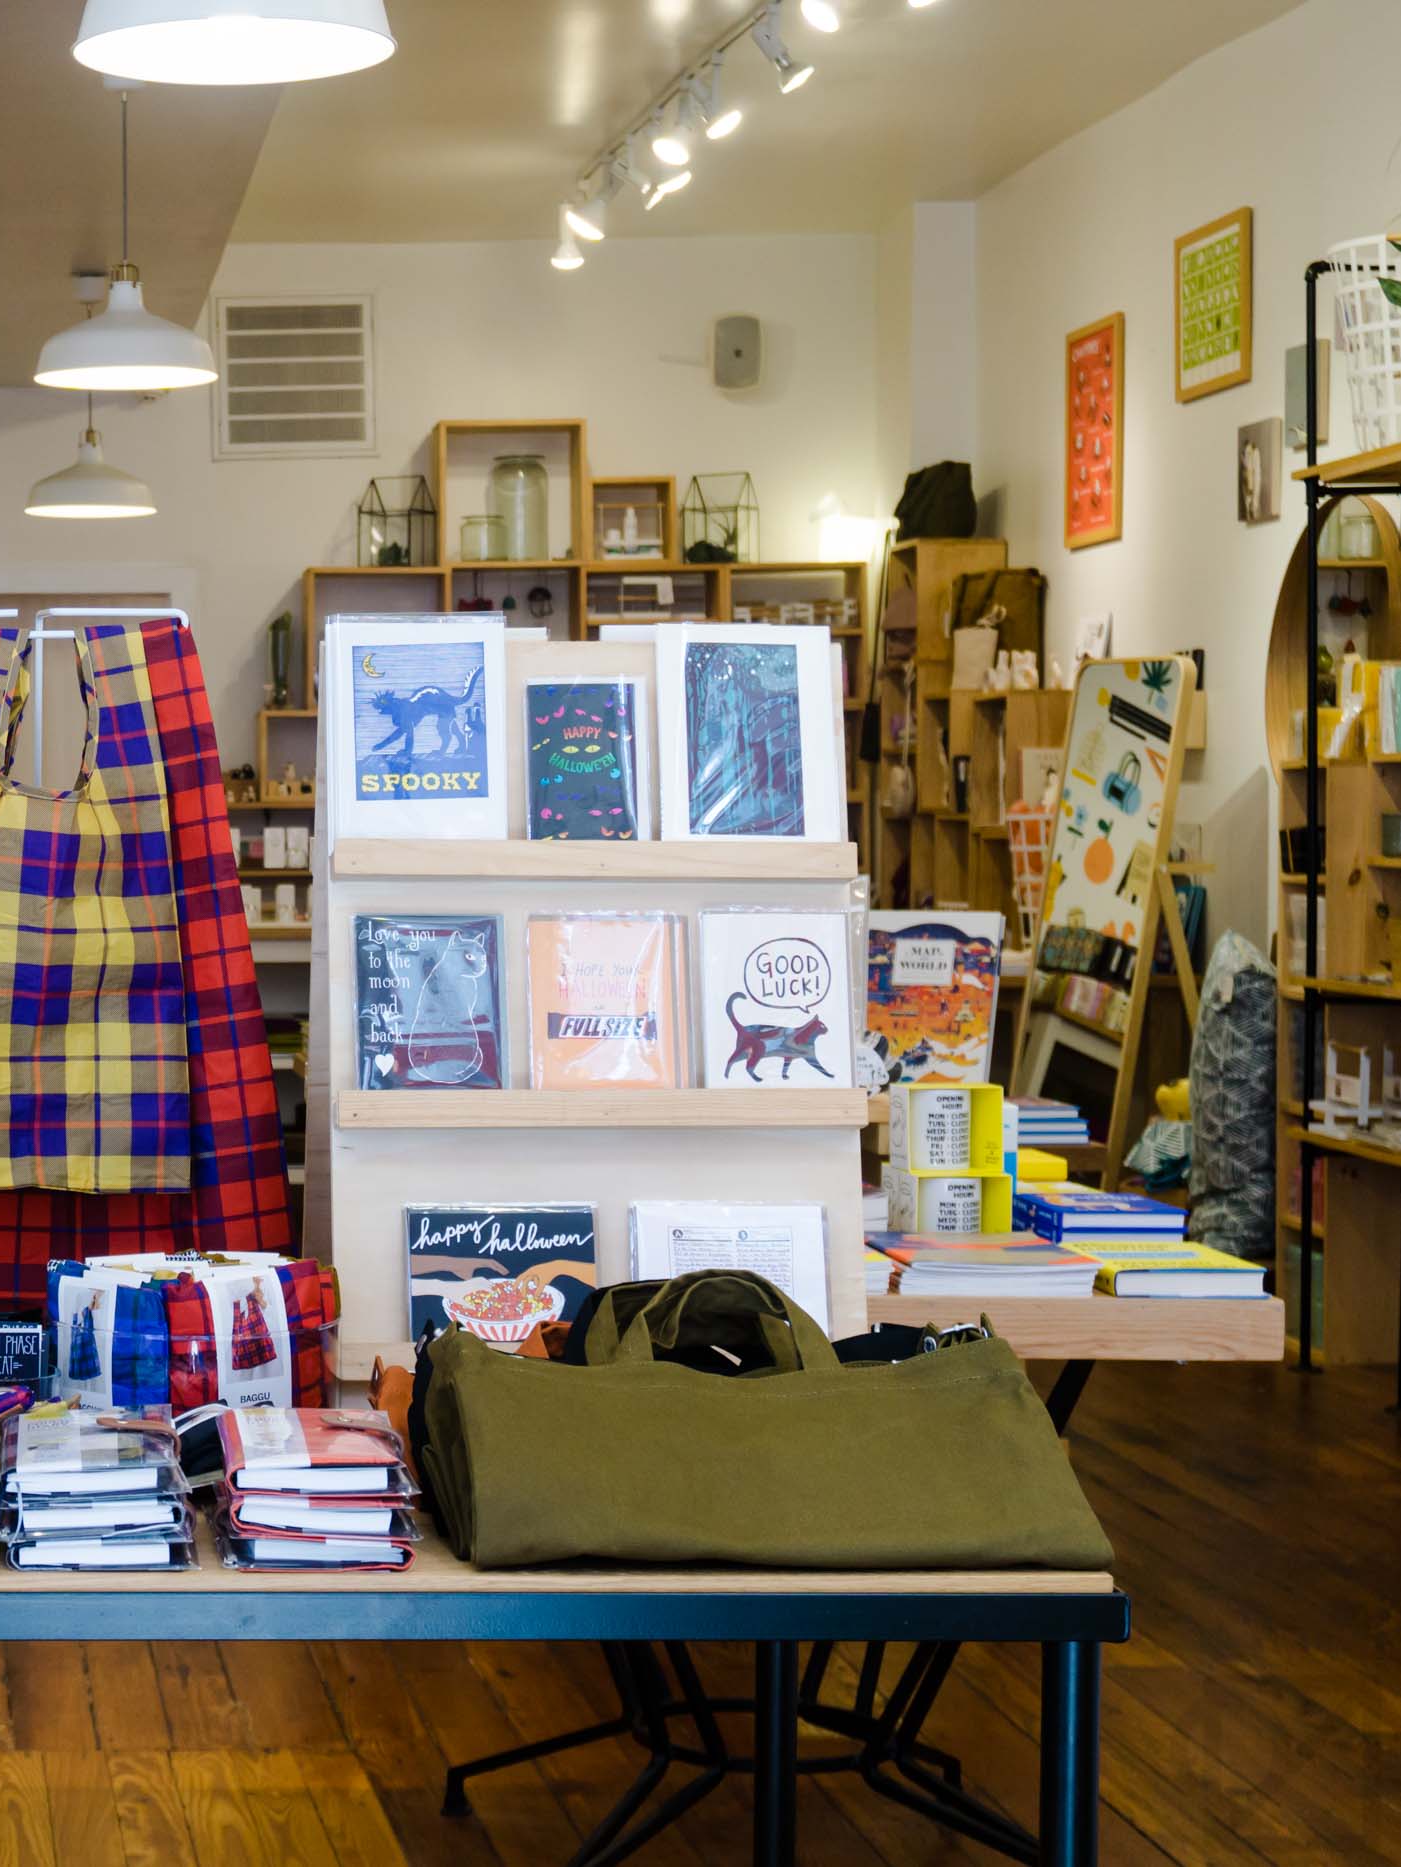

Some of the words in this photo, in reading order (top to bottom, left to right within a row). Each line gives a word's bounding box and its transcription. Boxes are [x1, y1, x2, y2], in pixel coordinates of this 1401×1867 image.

[562, 726, 601, 740] HAPPY
[361, 771, 481, 792] SPOOKY
[366, 920, 400, 945] Love
[406, 930, 436, 951] you
[368, 951, 381, 969] to
[386, 949, 411, 969] the
[575, 962, 604, 977] HOPE
[756, 952, 819, 978] GOOD
[368, 976, 410, 989] moon
[761, 976, 820, 998] LUCK!
[370, 994, 399, 1015] and
[370, 1022, 404, 1043] back
[411, 1215, 495, 1250] happy
[478, 1222, 594, 1255] halloween
[5, 1335, 38, 1355] PHASE
[240, 1392, 271, 1403] BAGGU
